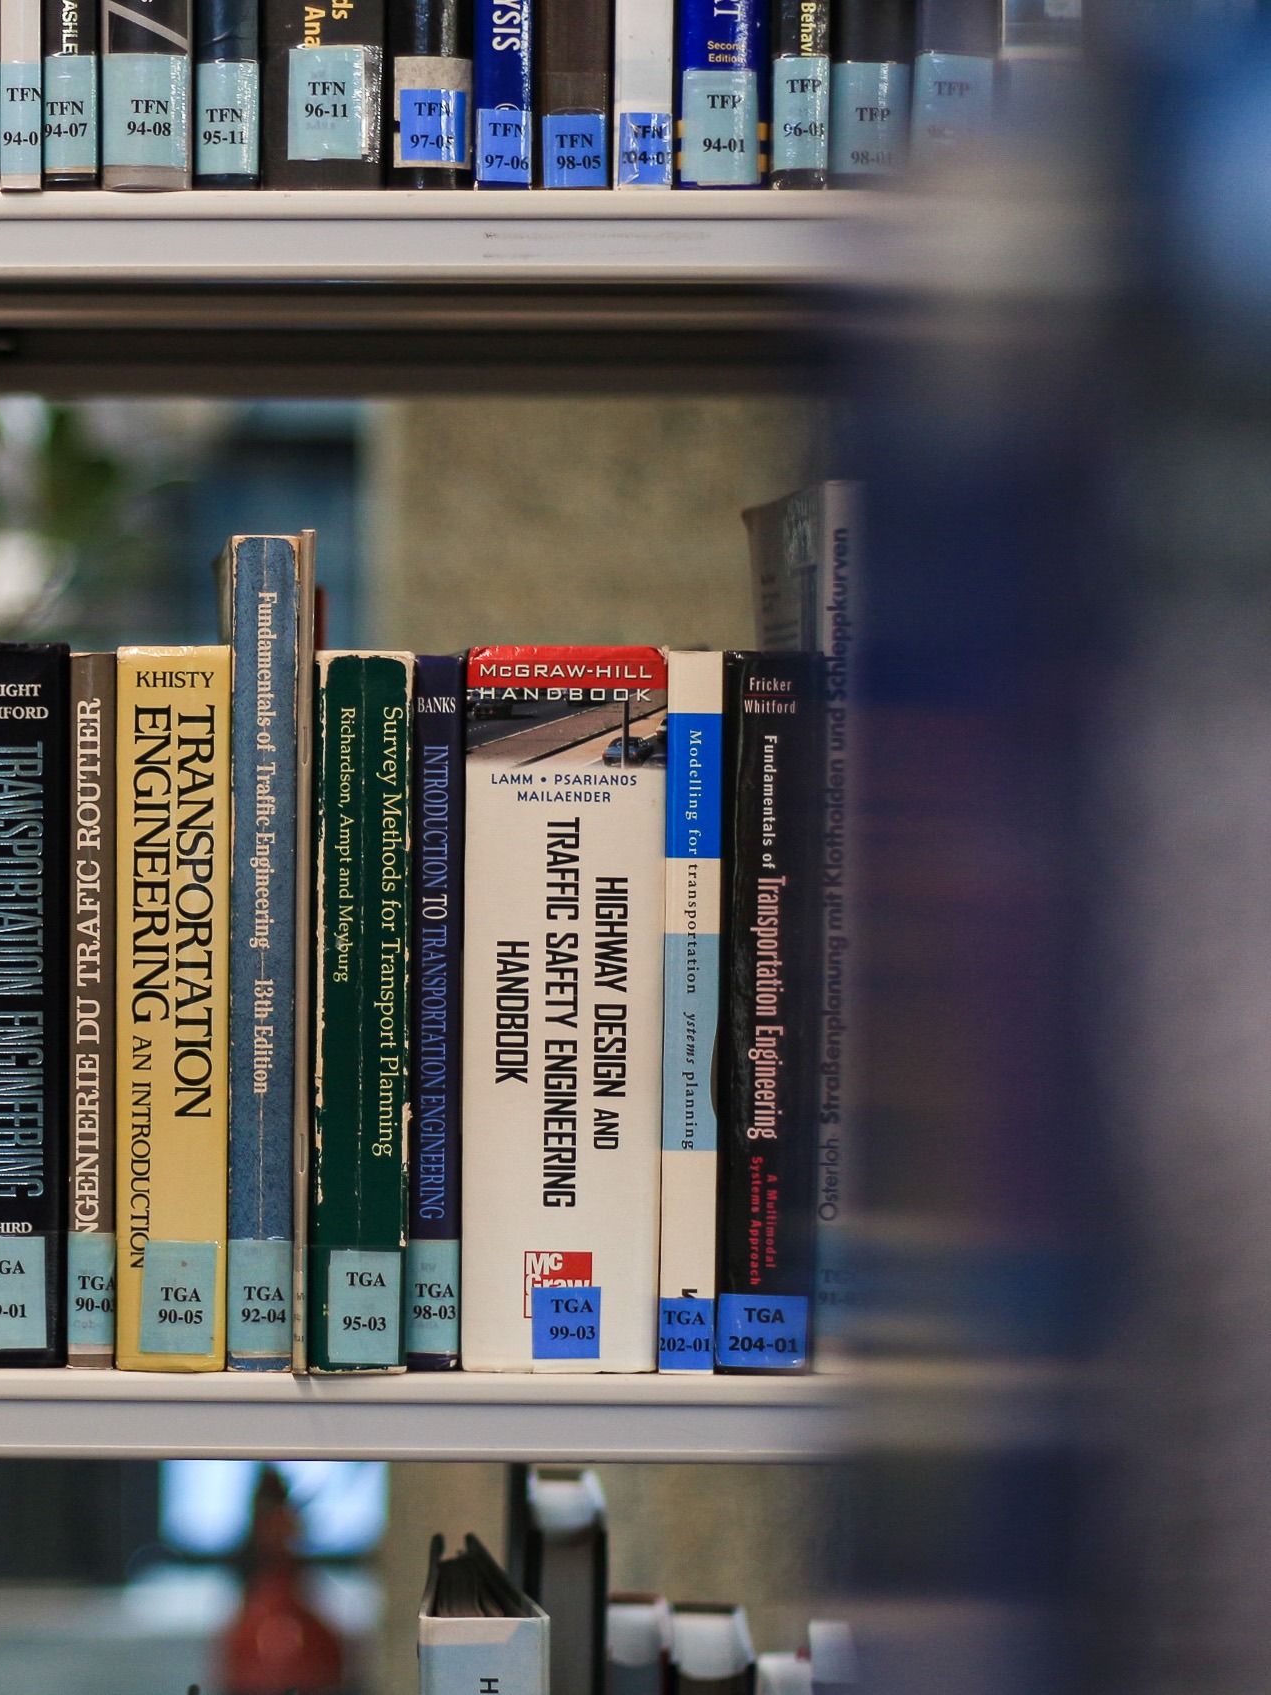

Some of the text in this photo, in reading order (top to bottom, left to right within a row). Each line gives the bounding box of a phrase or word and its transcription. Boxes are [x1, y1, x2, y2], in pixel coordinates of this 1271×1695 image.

[308, 81, 346, 96] TFN
[47, 101, 85, 115] TFN
[131, 99, 169, 115] TFN
[304, 103, 348, 118] 96-11
[206, 108, 243, 123] TFN
[44, 123, 88, 138] 94-07
[127, 121, 172, 136] 94-08
[555, 133, 593, 148] TFN
[703, 138, 745, 153] 94-01
[485, 154, 529, 170] 97-06
[556, 155, 602, 170] 98-05
[480, 664, 652, 678] McGRAW-HILL
[136, 671, 214, 688] KHISTY
[749, 677, 792, 691] Fricker
[480, 688, 651, 702] HANDBOOK
[417, 697, 456, 713] BANKS
[744, 700, 796, 714] Whitford
[491, 773, 637, 786] LAMM PSARIANOS
[517, 791, 611, 803] MAILAENDER
[250, 591, 278, 1094] Fundamentals Traffic Engineering Edition
[333, 707, 355, 982] Richardson, Ampt and Meyburg
[76, 698, 102, 1044] DU TRAFIC ROUTIER
[132, 704, 172, 1070] ENGINEERING AN
[175, 704, 215, 1118] TRANSPORTATION
[372, 706, 403, 1157] Survey Methods for Transport Planning
[681, 729, 702, 1150] Modelling transportation planning
[747, 735, 786, 1139] Fundamentals Transportation Engineering
[419, 745, 449, 1219] INTRODUCTION TO TRANSPORTATION ENGINEERING
[495, 940, 530, 1084] HANDBOOK
[543, 817, 580, 1207] TRAFFIC SAFETY ENGINEERING
[593, 876, 628, 1150] HIGHWAY DESIGN AND
[818, 936, 848, 1221] Osterloh Straßenplanung
[749, 1156, 763, 1285] Systems Approach
[765, 1189, 777, 1268] Multimodal
[525, 1253, 563, 1275] Mc
[346, 1272, 386, 1287] TGA
[161, 1287, 202, 1303] TGA
[244, 1286, 285, 1301] TGA
[415, 1283, 455, 1299] TGA
[413, 1305, 456, 1320] 98-03
[551, 1298, 594, 1314] TGA
[158, 1308, 203, 1325] 90-05
[241, 1308, 286, 1323] 92-04
[342, 1316, 387, 1331] 95-03
[663, 1310, 705, 1326] TGA
[744, 1308, 785, 1324] TGA
[549, 1325, 596, 1341] 99-03
[660, 1337, 710, 1352] 202-01
[729, 1336, 798, 1353] 204-01
